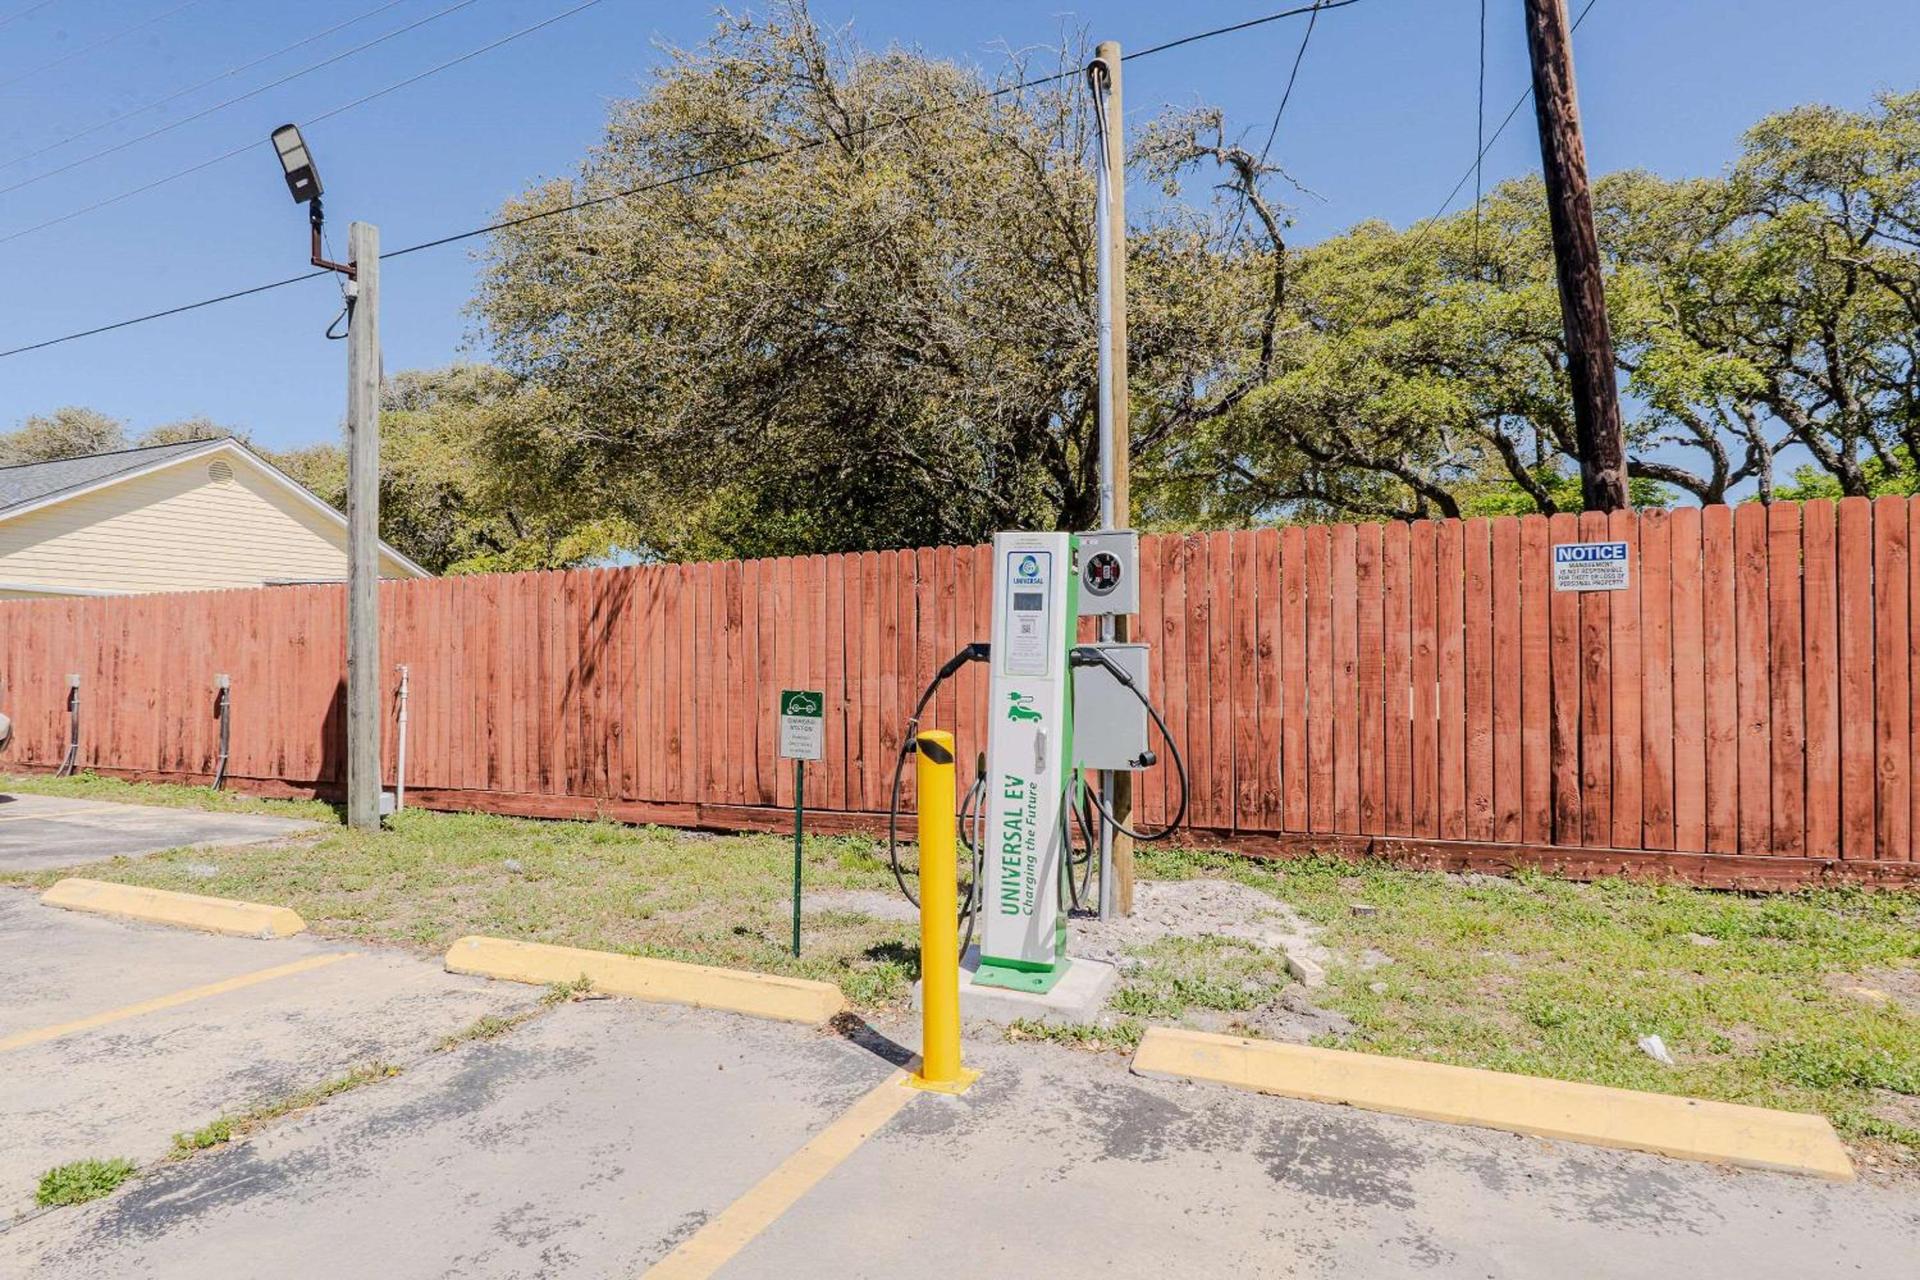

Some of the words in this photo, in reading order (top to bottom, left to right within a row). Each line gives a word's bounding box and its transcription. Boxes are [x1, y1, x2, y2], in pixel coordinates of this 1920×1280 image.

[1558, 546, 1624, 561] NOTICE
[1005, 775, 1024, 799] EV
[1026, 782, 1037, 826] Future
[1025, 830, 1035, 850] the
[1001, 808, 1023, 915] UNIVERSAL
[1022, 855, 1037, 916] Charging
